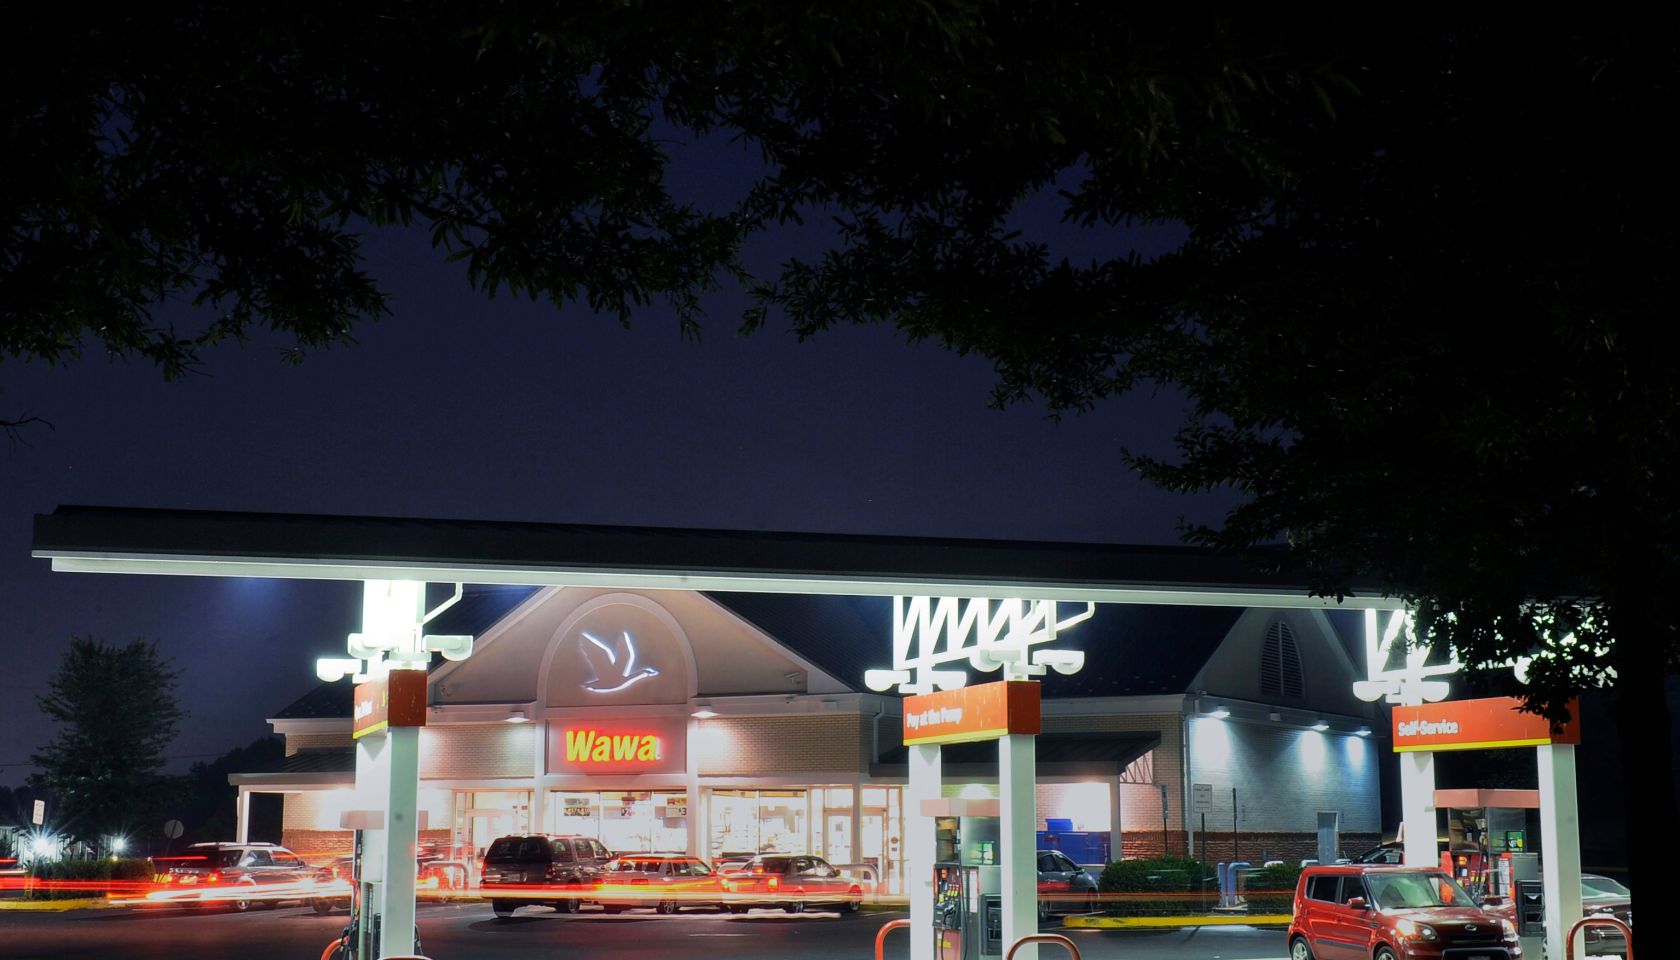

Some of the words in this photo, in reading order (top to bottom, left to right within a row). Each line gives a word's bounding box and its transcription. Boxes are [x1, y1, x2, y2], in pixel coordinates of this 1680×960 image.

[907, 712, 919, 730] Pay
[928, 709, 940, 724] the
[941, 707, 962, 725] Pump
[1398, 718, 1458, 737] Self-Service
[566, 730, 658, 762] Wawa
